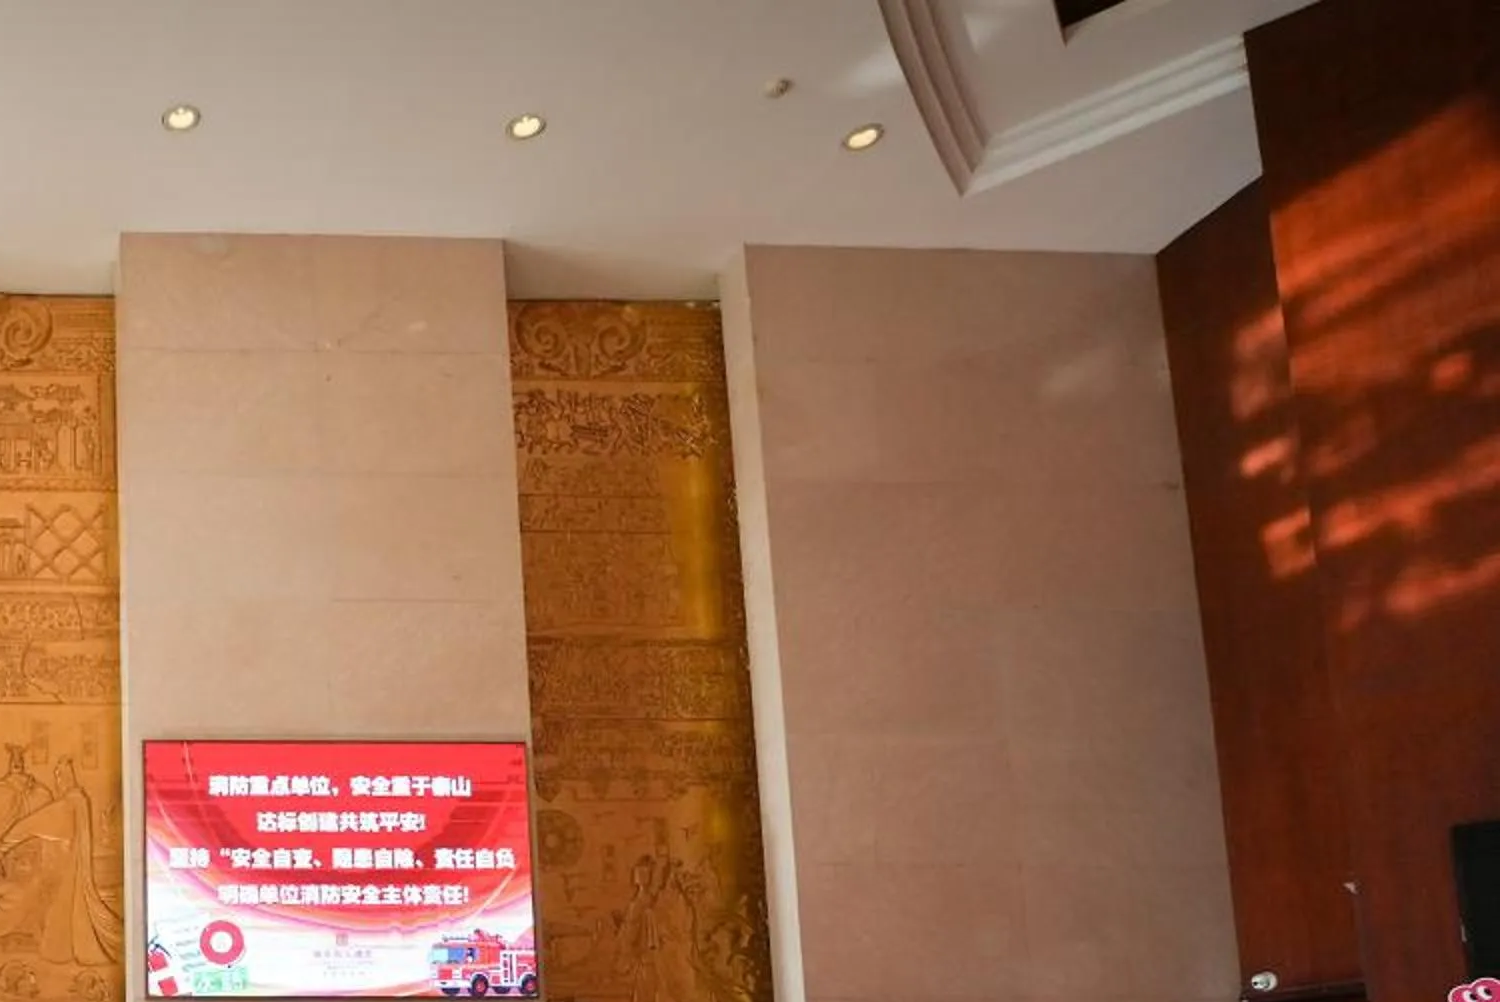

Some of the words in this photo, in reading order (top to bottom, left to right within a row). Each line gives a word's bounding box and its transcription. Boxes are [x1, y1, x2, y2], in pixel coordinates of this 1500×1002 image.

[208, 775, 472, 797] 消防重点单位，安全重于泰山
